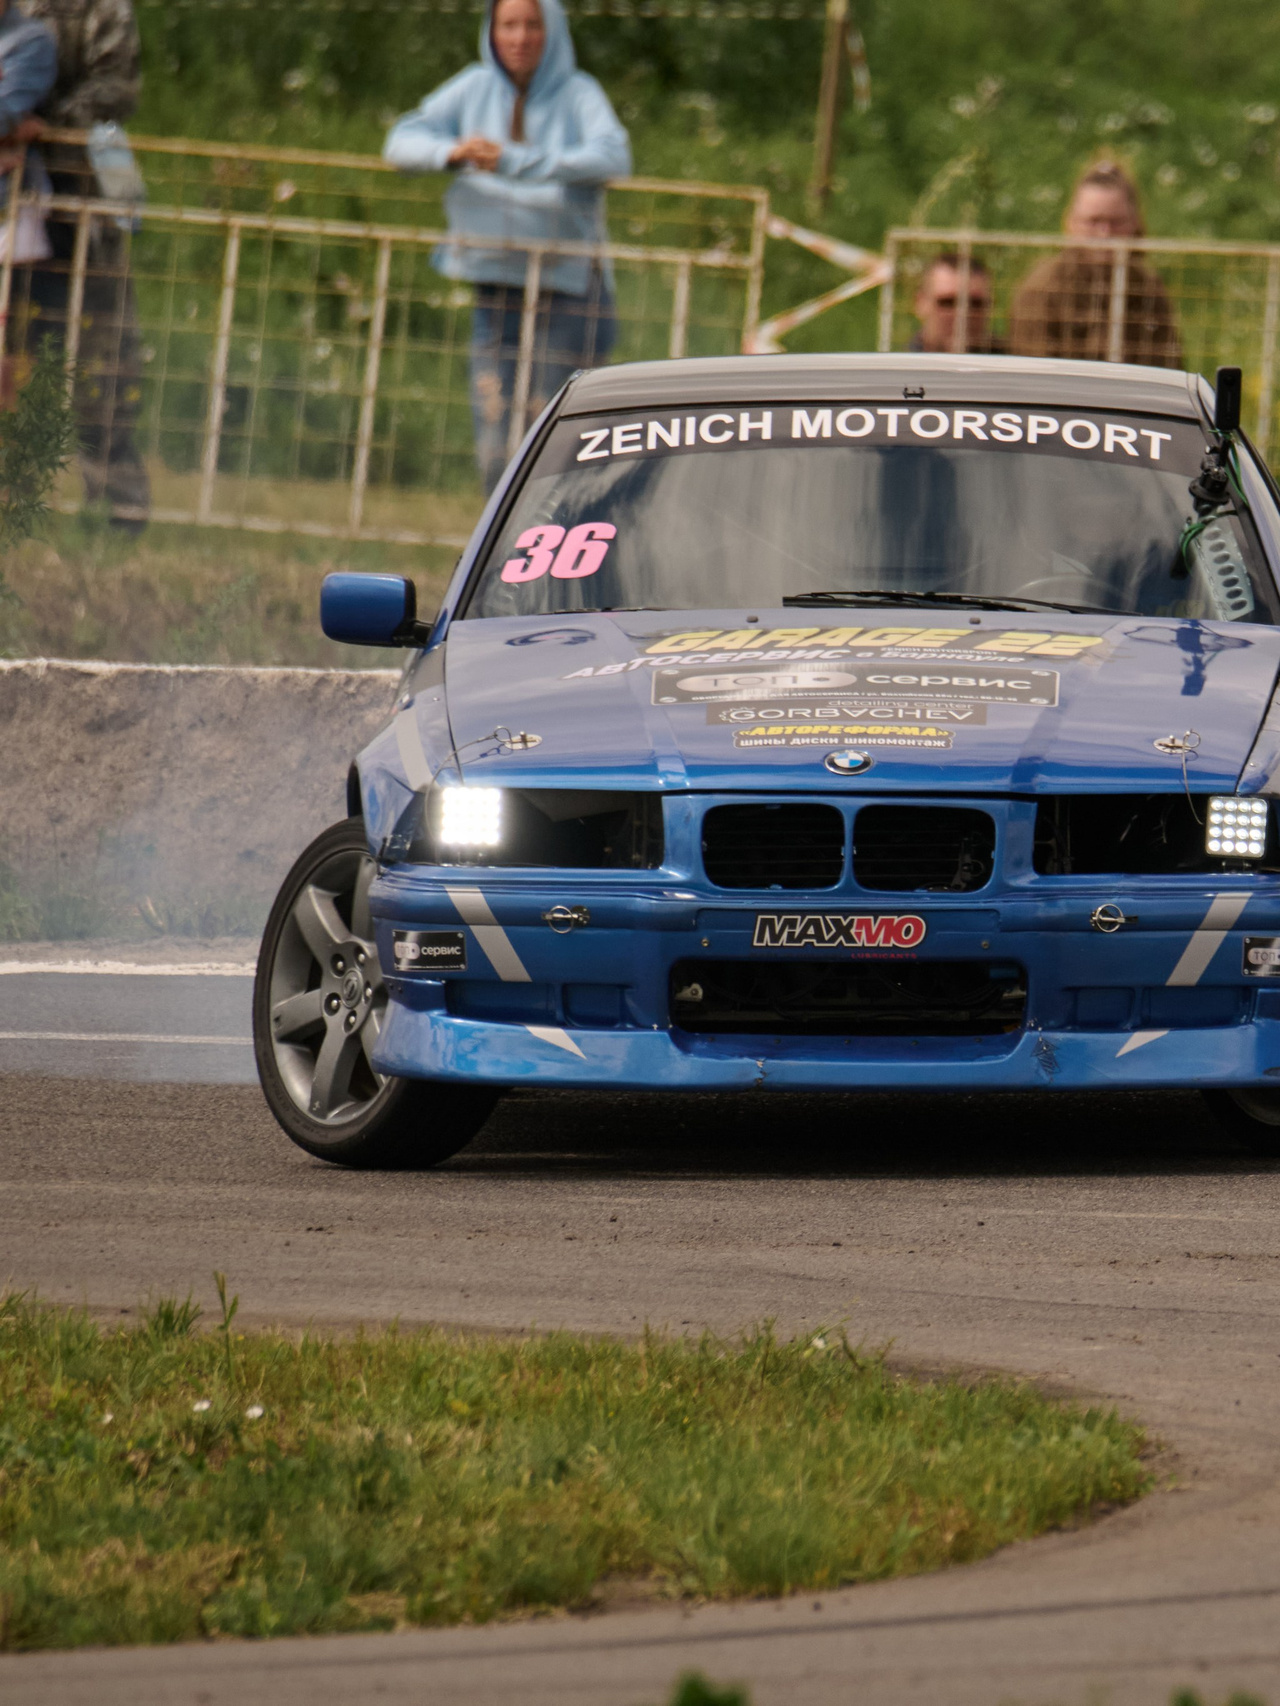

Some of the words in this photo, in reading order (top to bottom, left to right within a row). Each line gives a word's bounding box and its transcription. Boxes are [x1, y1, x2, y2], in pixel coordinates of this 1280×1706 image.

[576, 411, 773, 462] ZENICH
[791, 408, 1172, 460] MOTORSPORT
[501, 522, 617, 583] 36
[645, 627, 975, 654] GARAGE
[973, 631, 1103, 657] 22
[561, 648, 851, 680] АВТОСЕРВИС
[880, 651, 1025, 664] Барнауле
[866, 674, 1032, 690] сервис
[729, 707, 974, 720] GORBACHEV
[828, 699, 909, 709] detailing
[914, 700, 974, 709] center
[738, 725, 949, 737] «АВТОРЕФОРМА»
[753, 915, 927, 948] MAXMO
[421, 946, 462, 957] сервис
